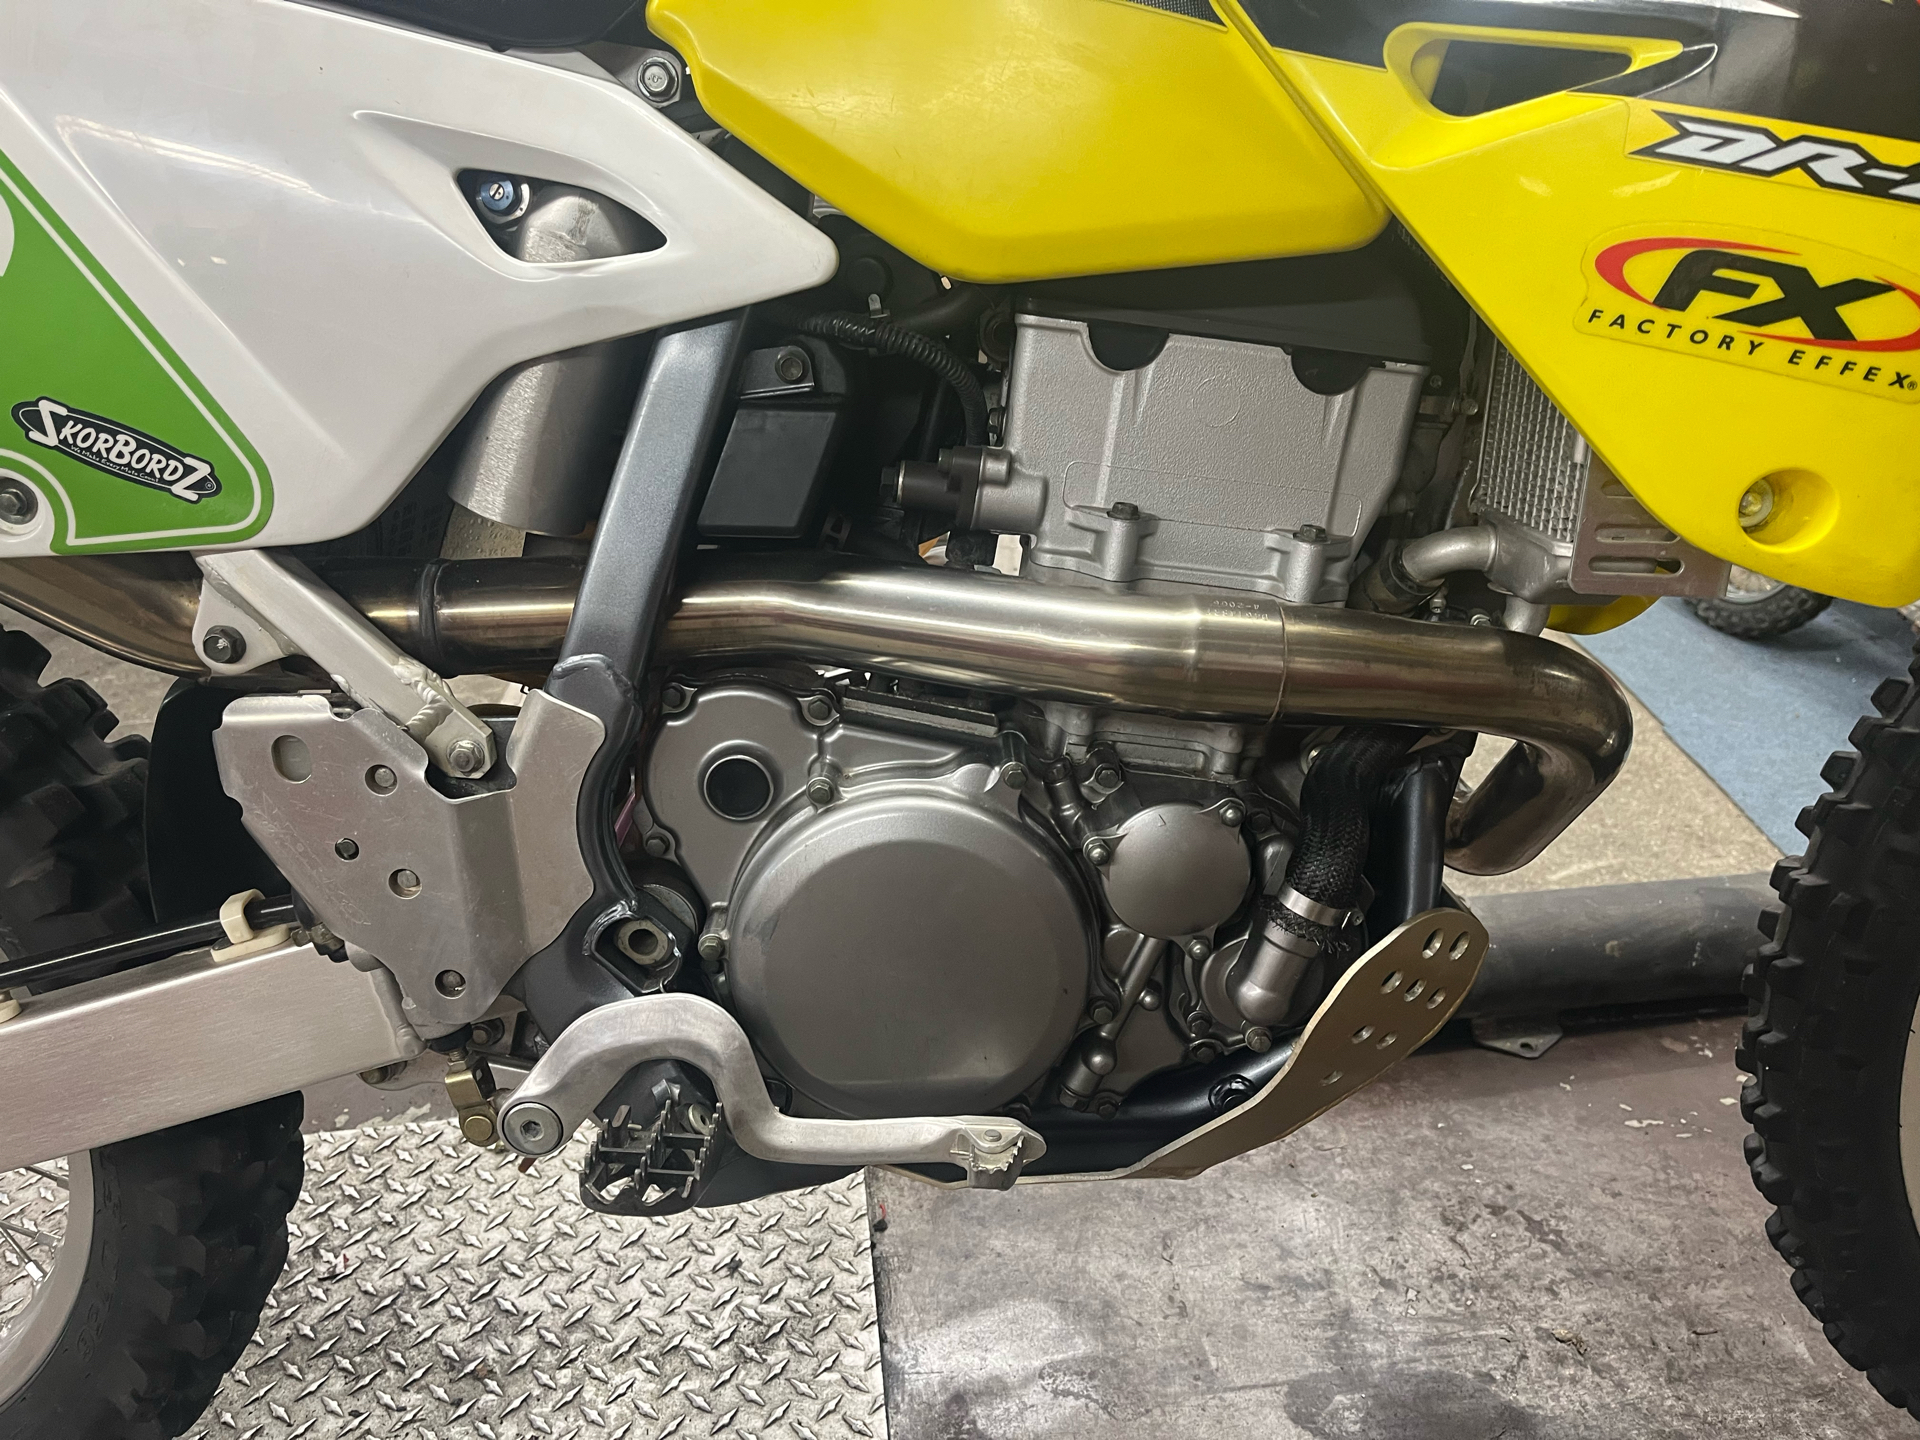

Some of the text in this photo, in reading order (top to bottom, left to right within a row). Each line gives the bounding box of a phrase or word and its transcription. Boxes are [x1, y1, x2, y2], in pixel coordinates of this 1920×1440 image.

[1653, 119, 1920, 199] DR-
[1652, 248, 1898, 342] FX
[1587, 309, 1765, 357] FACTORY
[81, 450, 100, 462] Make
[101, 458, 121, 471] Every
